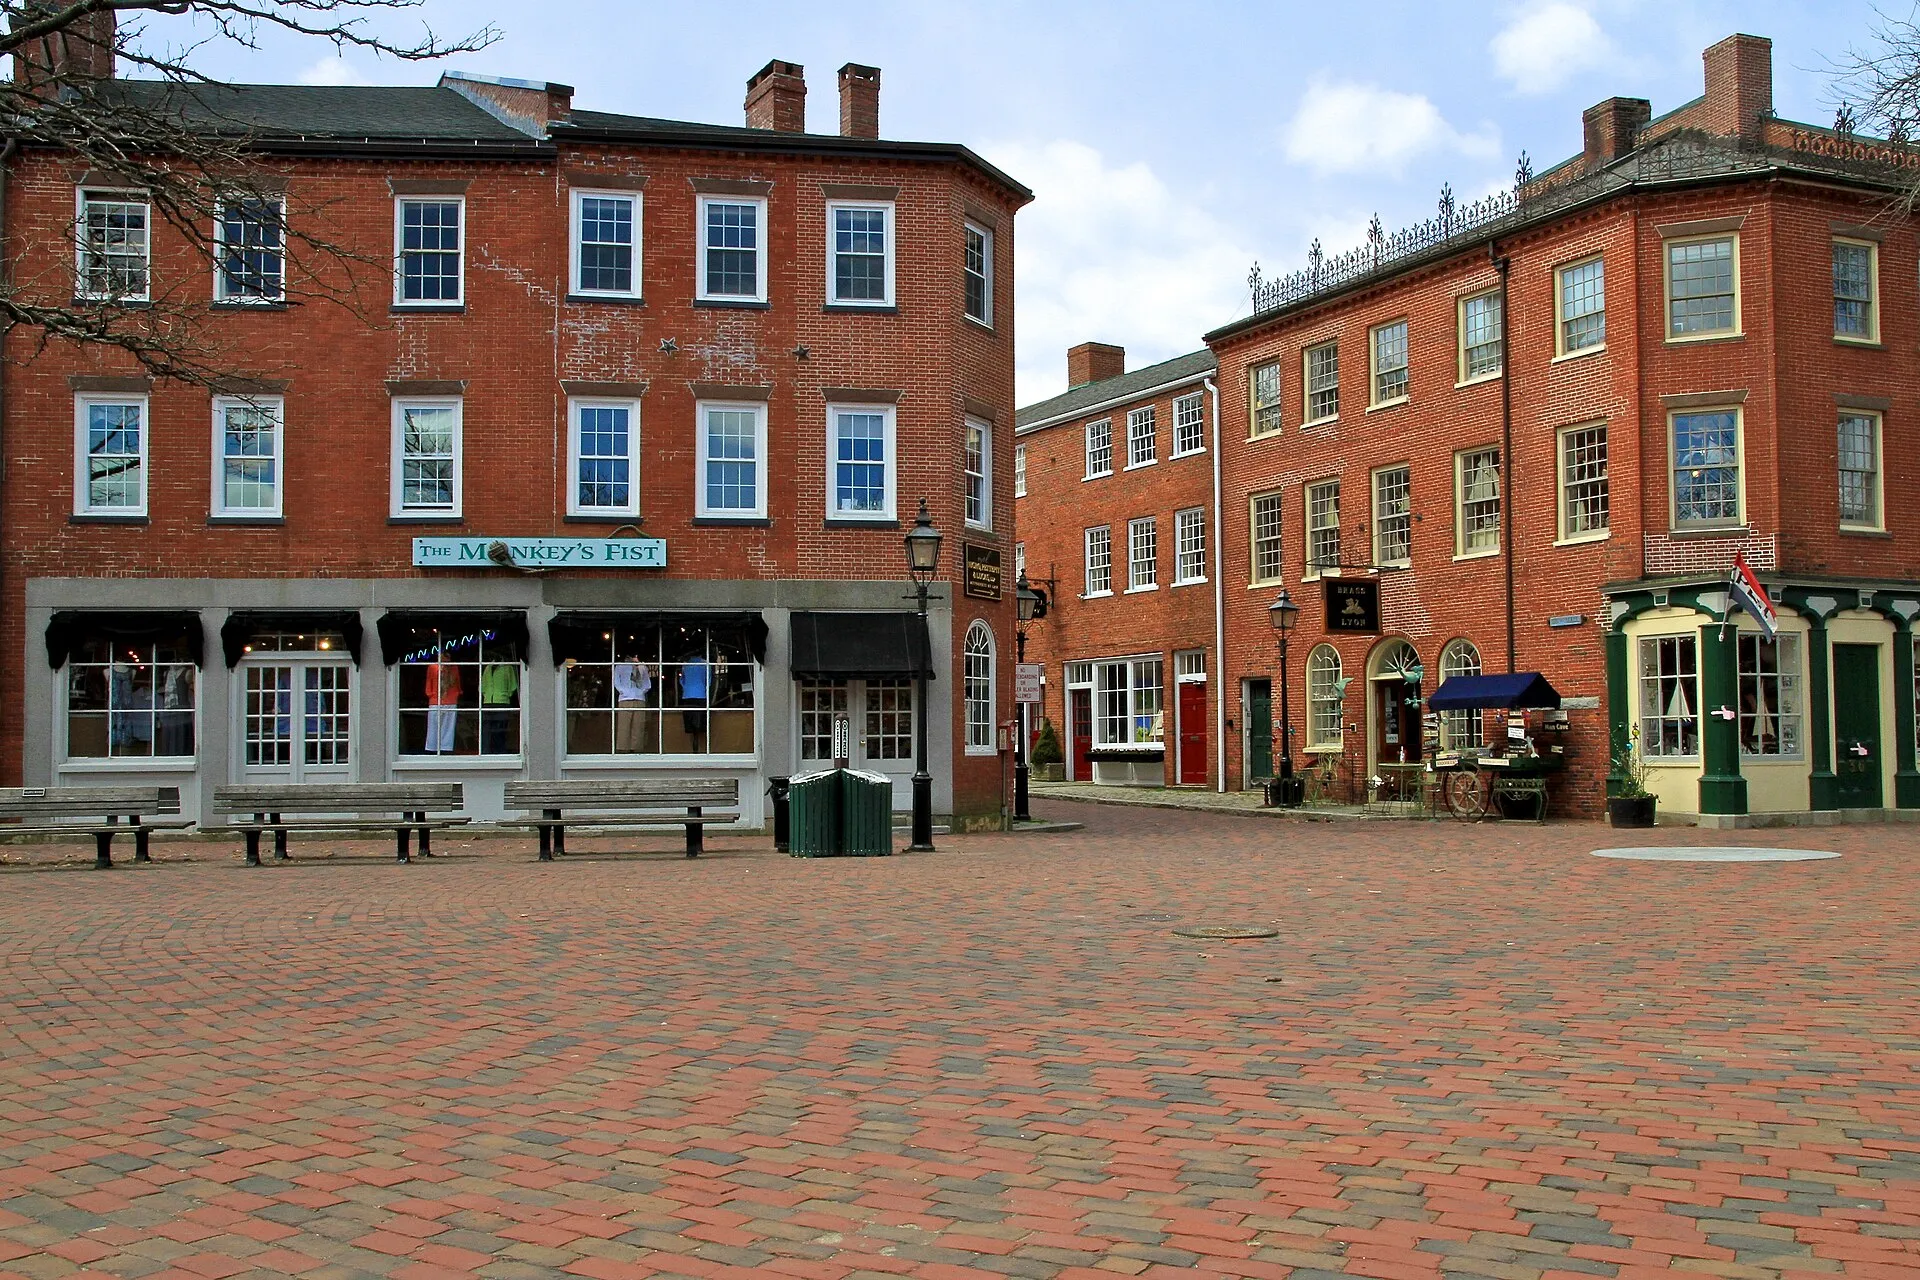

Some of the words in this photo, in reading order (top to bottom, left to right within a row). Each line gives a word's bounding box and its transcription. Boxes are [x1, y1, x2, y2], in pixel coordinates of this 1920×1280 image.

[420, 545, 451, 556] THE
[458, 543, 594, 561] MNKEY'S
[605, 543, 659, 560] FIST
[1337, 586, 1366, 595] BRASS
[1341, 618, 1366, 626] LYON
